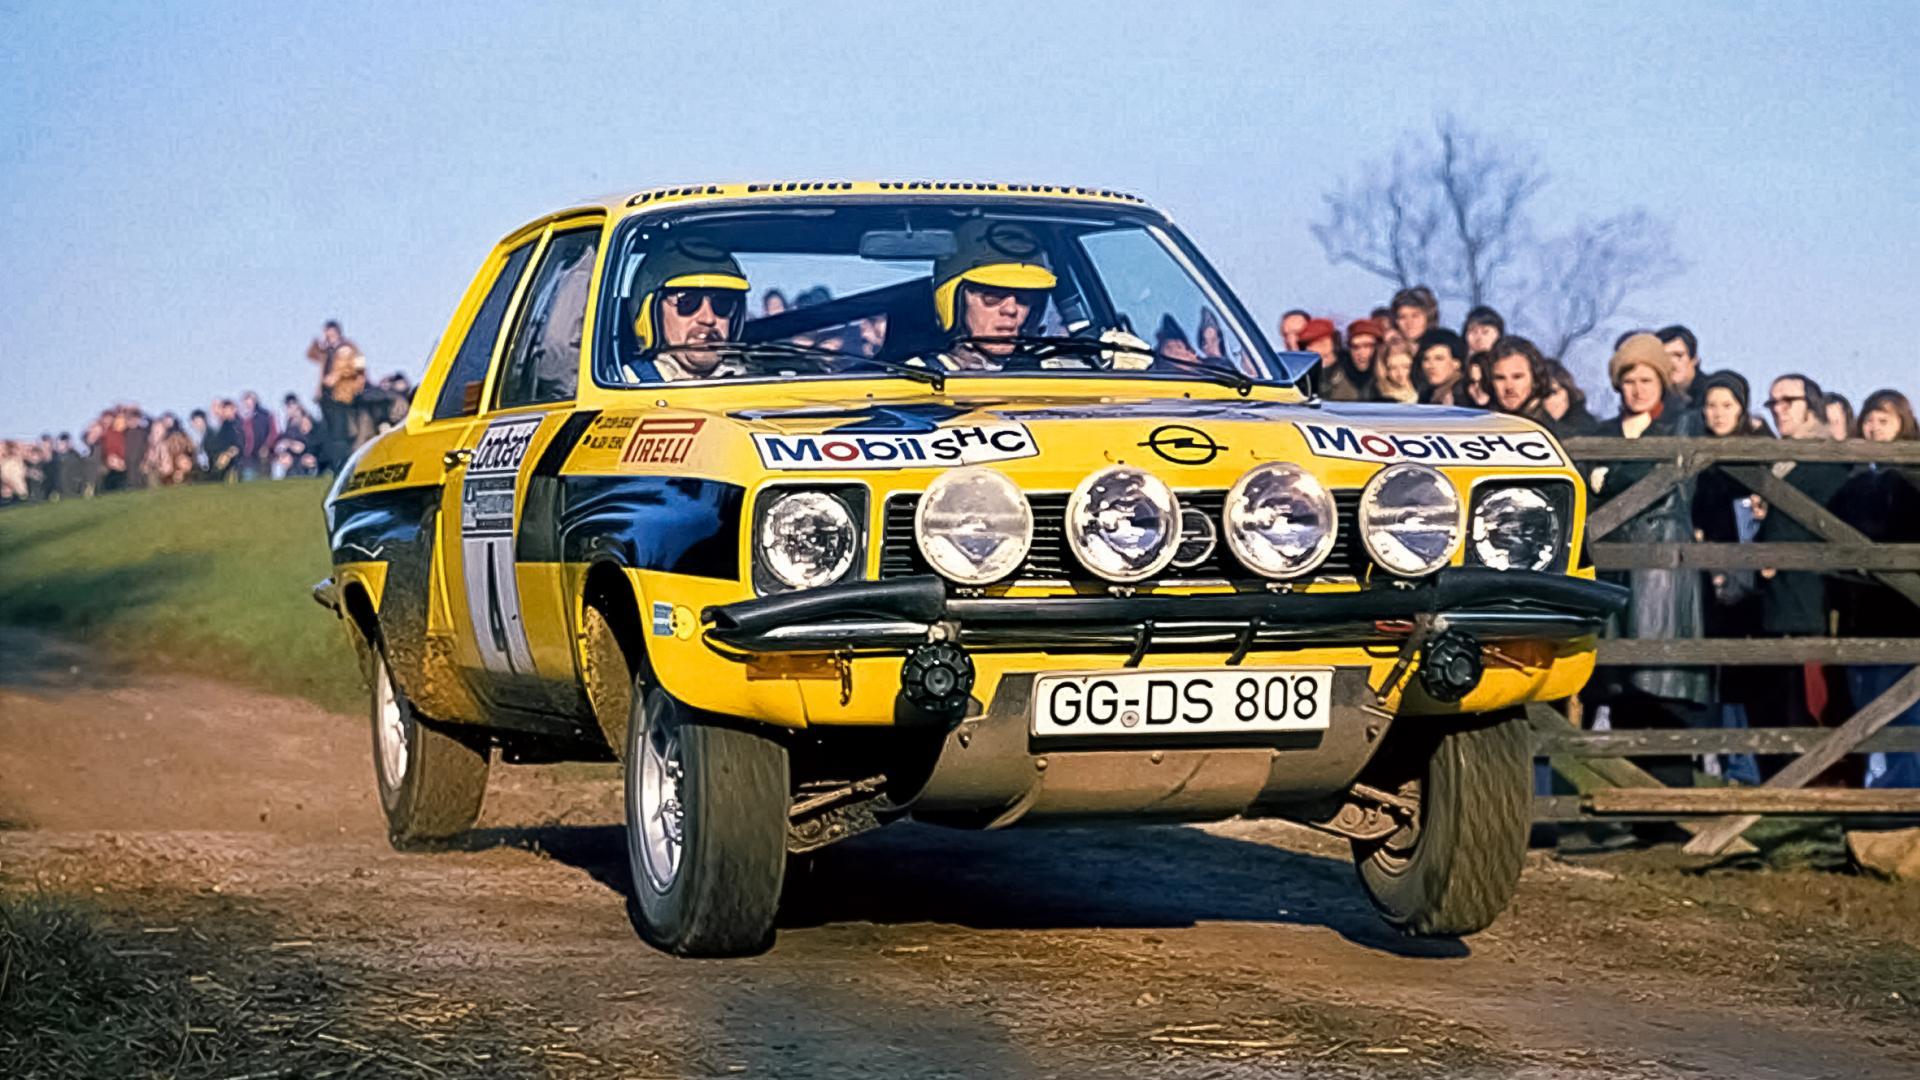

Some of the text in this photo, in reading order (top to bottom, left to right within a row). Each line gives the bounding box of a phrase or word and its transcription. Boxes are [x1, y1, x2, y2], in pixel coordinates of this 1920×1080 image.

[622, 418, 707, 463] PIRELLI
[765, 437, 926, 461] Mobil
[1306, 425, 1460, 458] Mobil
[1050, 676, 1318, 726] GG-DS 808
